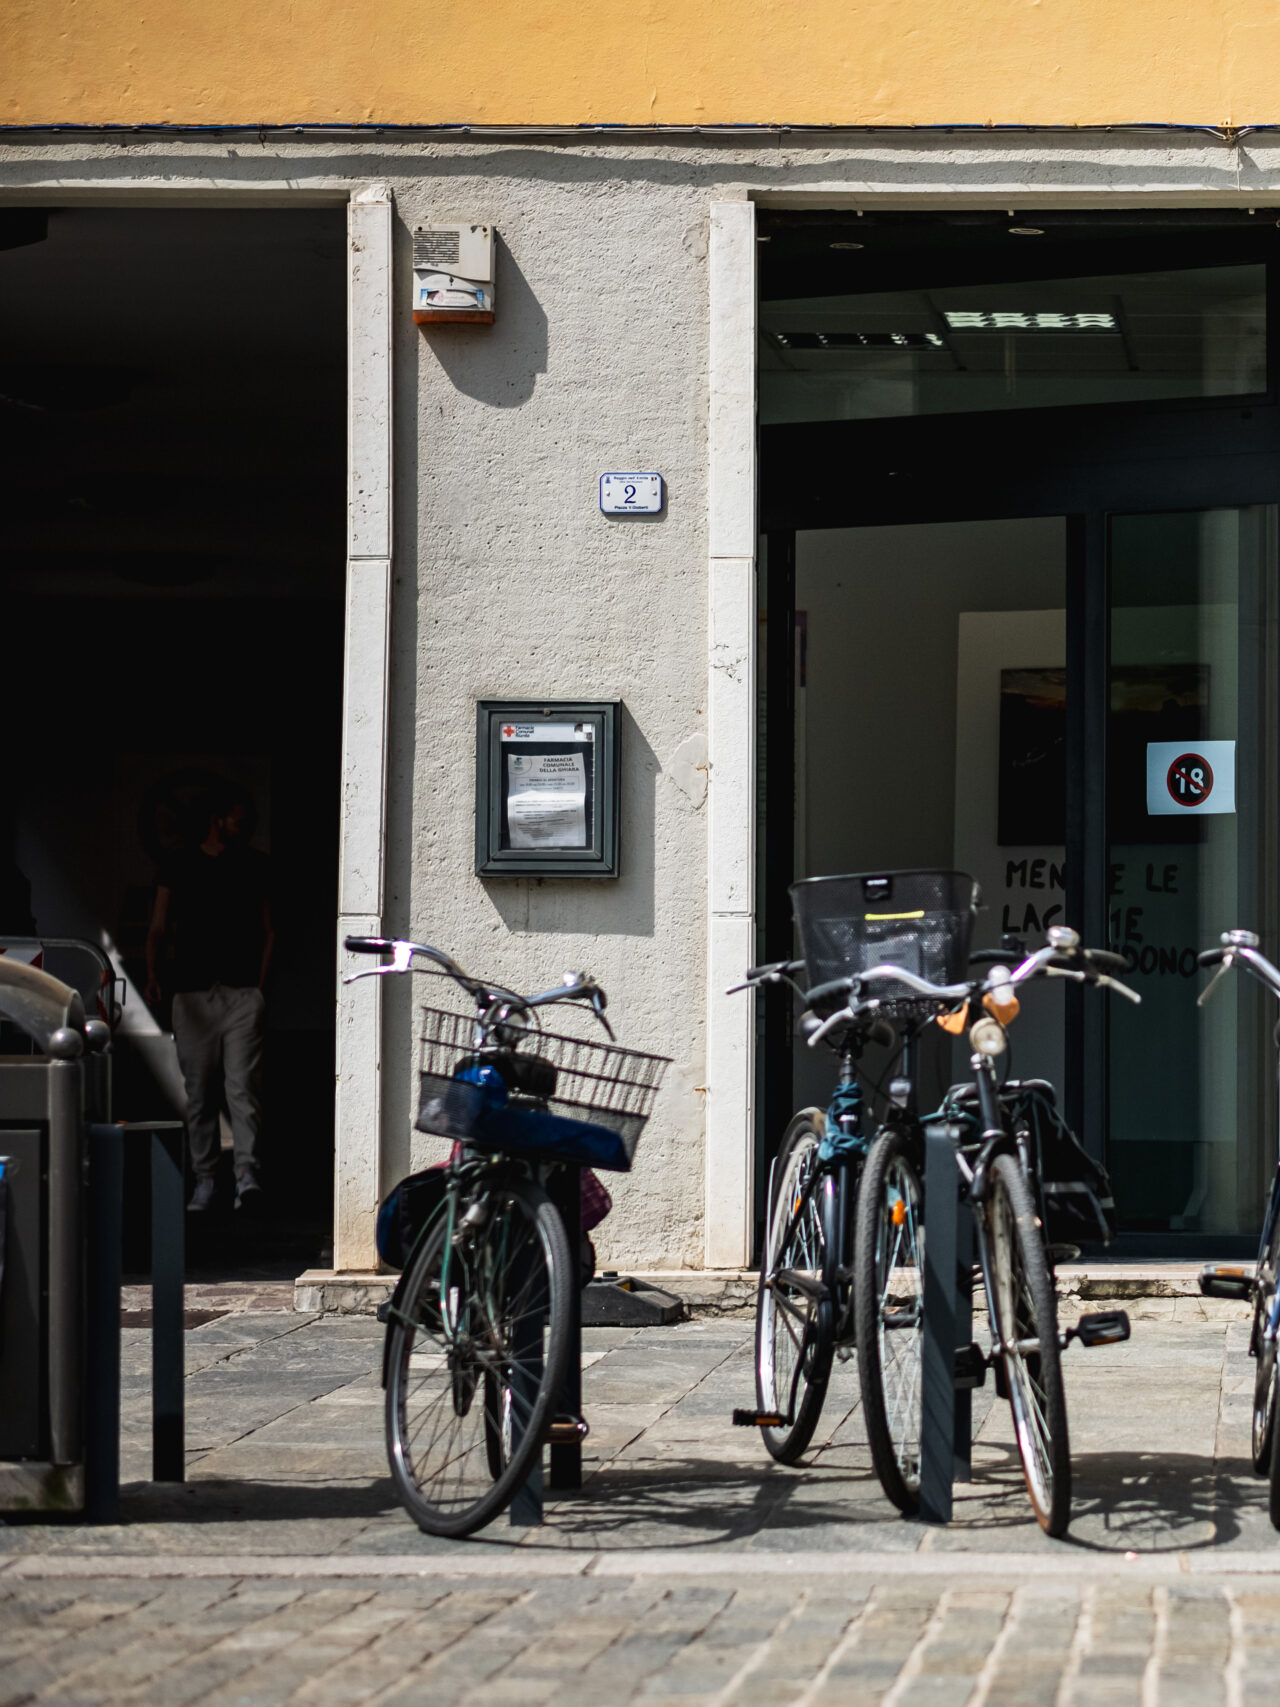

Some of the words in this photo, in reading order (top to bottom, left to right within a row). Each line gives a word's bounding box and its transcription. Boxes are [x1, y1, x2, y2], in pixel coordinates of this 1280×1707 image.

[624, 484, 636, 504] 2
[1175, 767, 1204, 794] 18
[1146, 863, 1179, 893] LE
